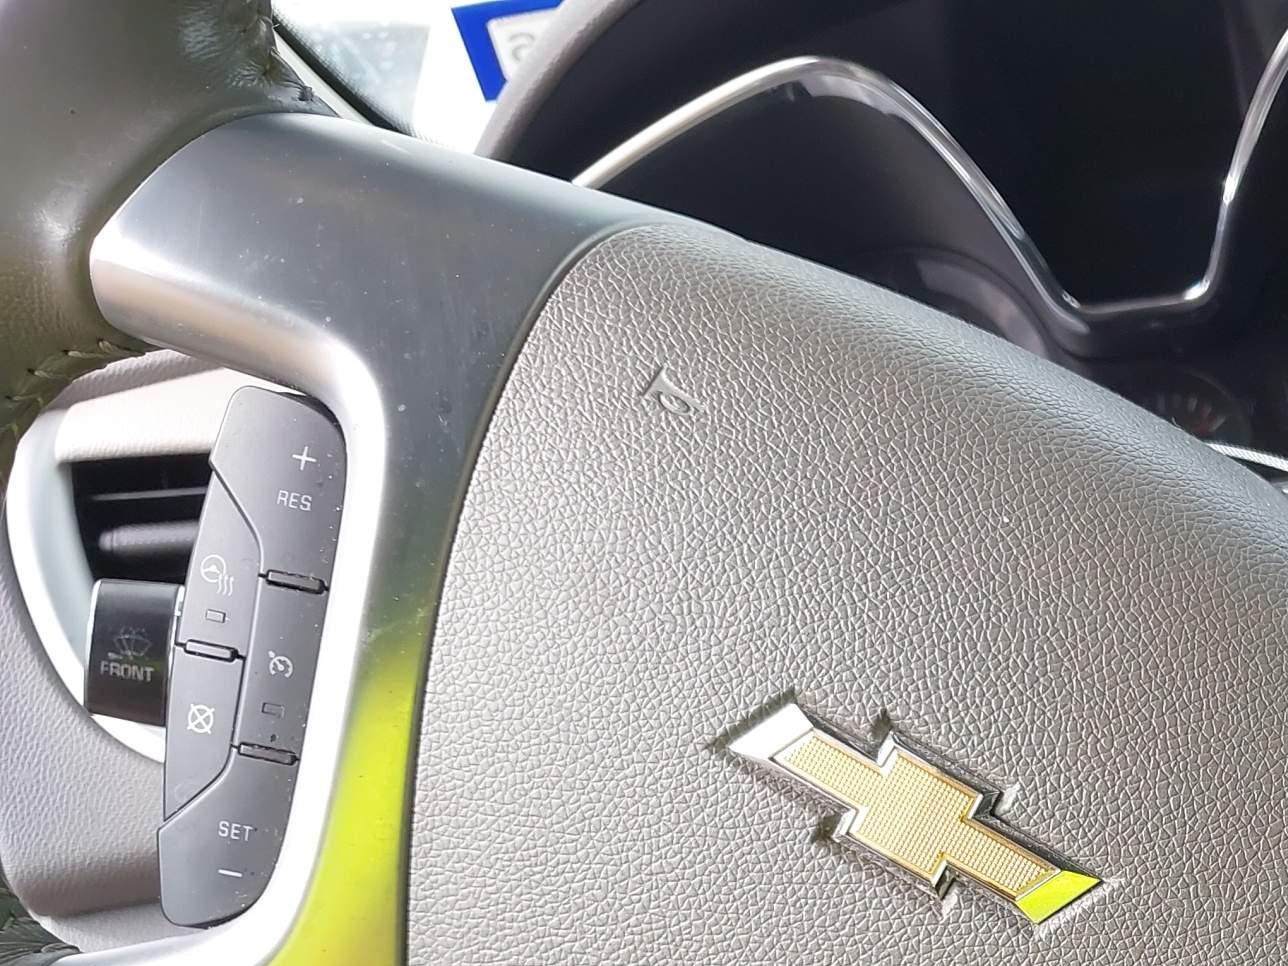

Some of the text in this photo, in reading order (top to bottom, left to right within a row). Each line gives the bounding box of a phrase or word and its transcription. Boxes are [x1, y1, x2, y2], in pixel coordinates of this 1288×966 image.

[276, 489, 313, 511] RES
[100, 660, 155, 682] FRONT
[218, 820, 254, 841] SET
